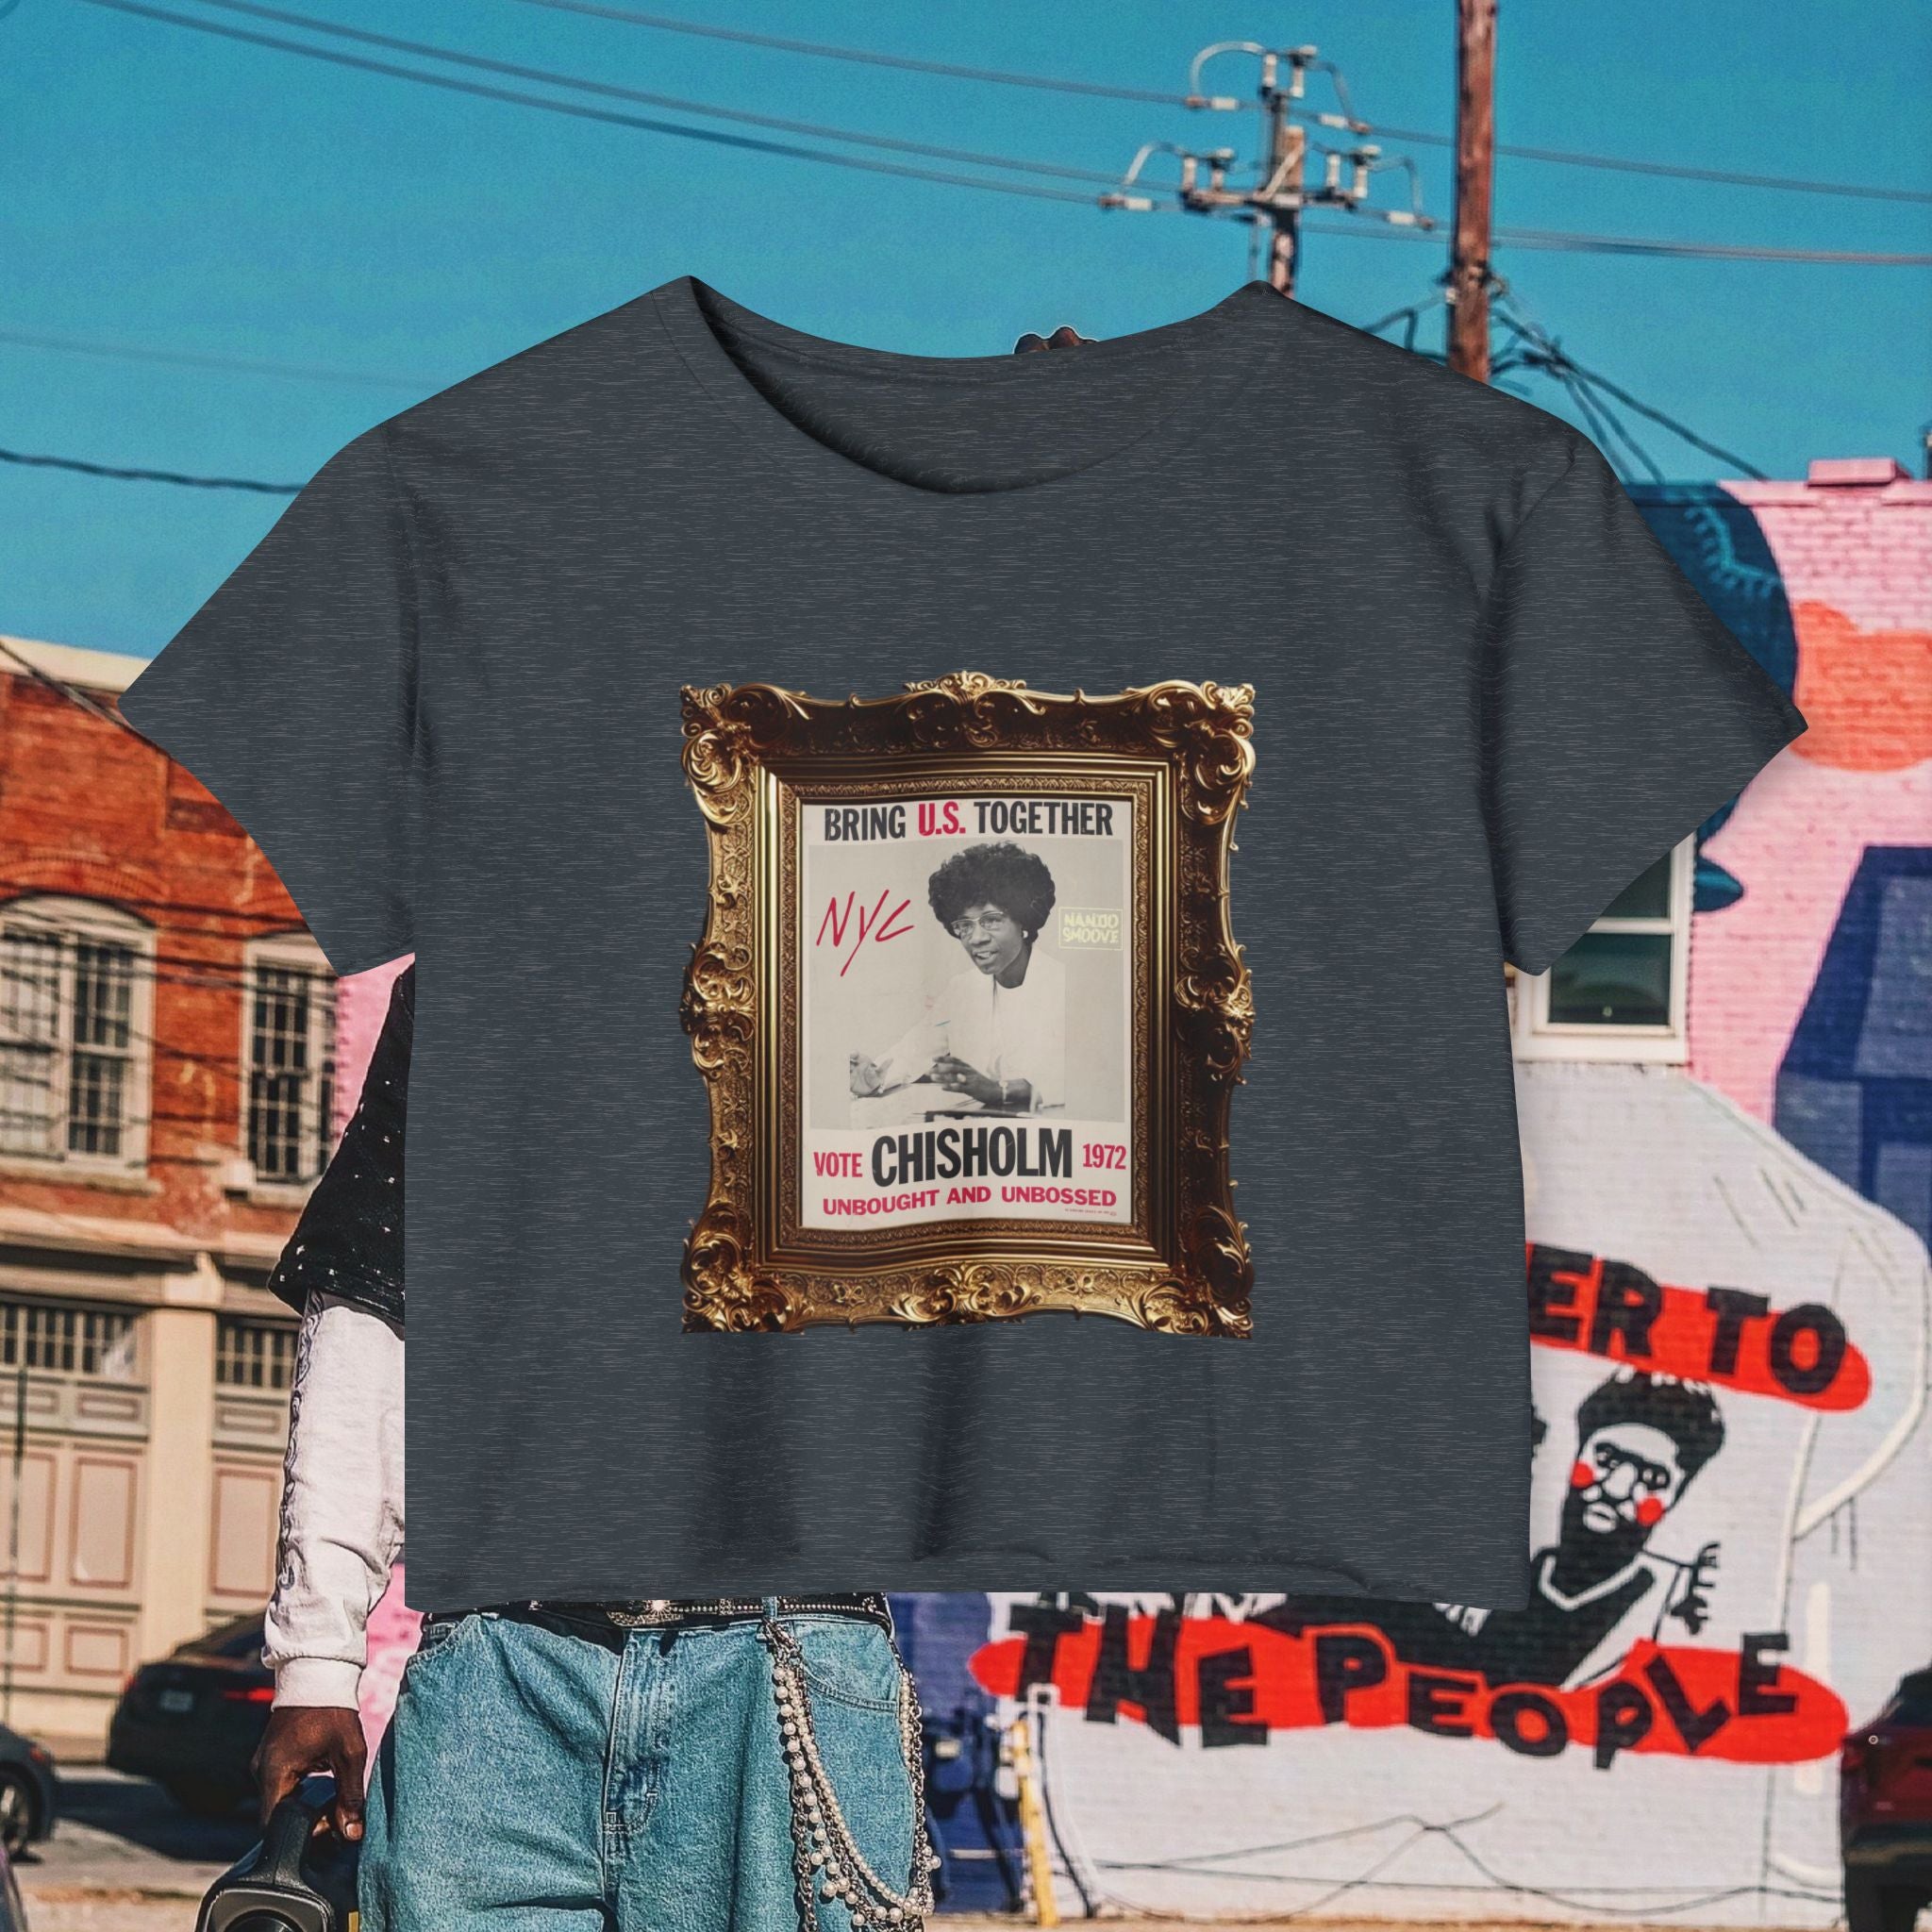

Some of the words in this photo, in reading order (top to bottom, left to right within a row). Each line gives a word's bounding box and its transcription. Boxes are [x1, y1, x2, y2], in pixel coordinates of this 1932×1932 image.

[824, 805, 906, 841] BRING
[917, 801, 966, 837] U.S.
[974, 801, 1113, 836] TOGETHER
[816, 890, 915, 977] NYC
[1062, 926, 1119, 943] SMOOVE
[813, 1151, 863, 1178] VOTE
[872, 1125, 1073, 1188] CHISHOLM
[1082, 1142, 1127, 1171] 1972
[823, 1189, 941, 1216] UNBOUGHT
[946, 1186, 991, 1205] AND
[1002, 1186, 1117, 1208] UNBOSSED
[1707, 1286, 1847, 1394] TO
[1008, 1602, 1269, 1748] THE
[1319, 1631, 1799, 1770] PEOPLE
